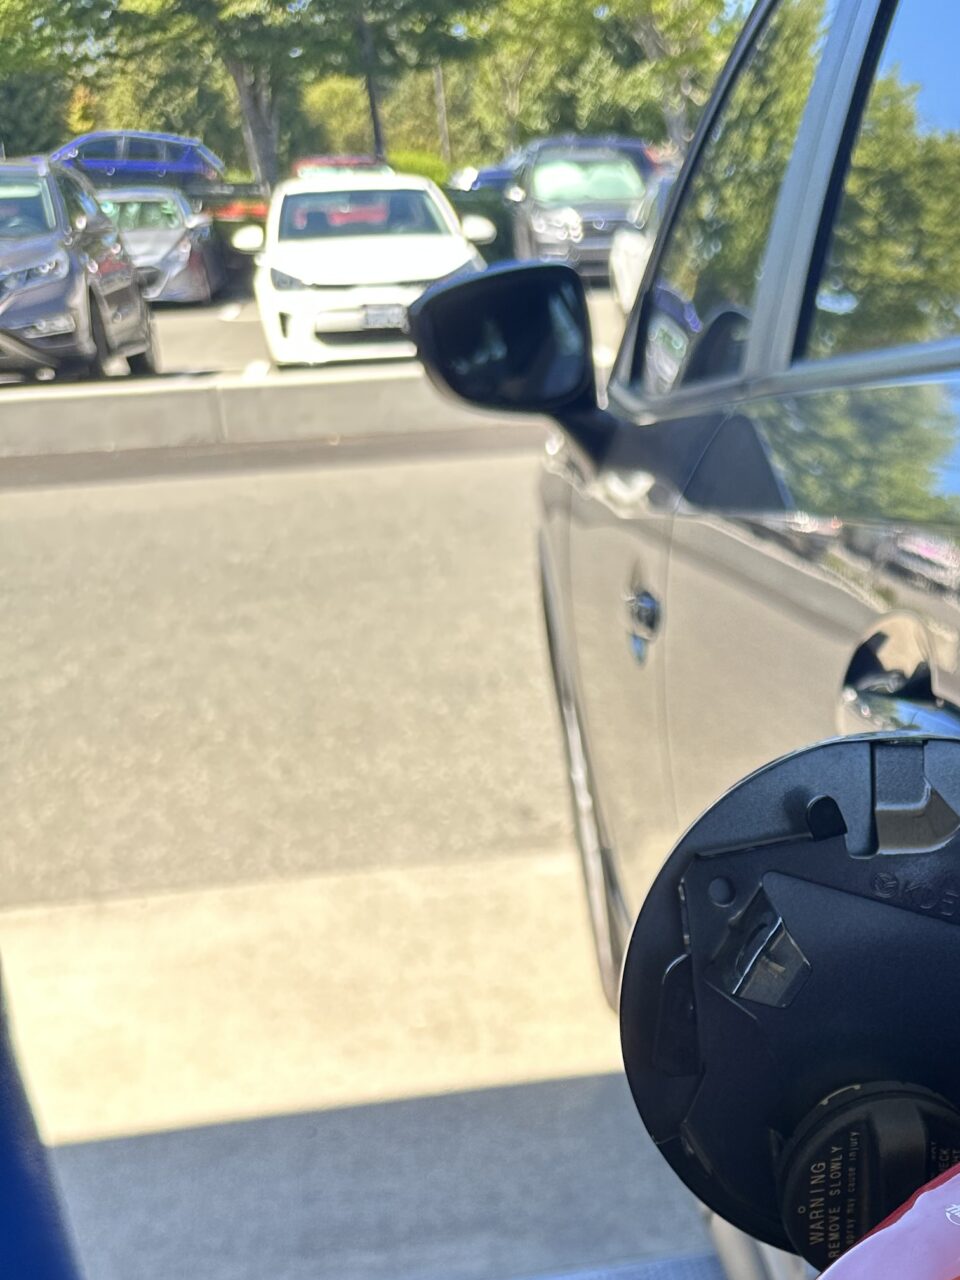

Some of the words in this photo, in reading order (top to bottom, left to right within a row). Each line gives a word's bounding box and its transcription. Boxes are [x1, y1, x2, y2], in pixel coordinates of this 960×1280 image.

[829, 1144, 843, 1196] SLOWLY
[847, 1130, 860, 1160] injury
[808, 1160, 826, 1245] WARNING
[846, 1165, 856, 1192] cause
[826, 1205, 840, 1258] REMOVE
